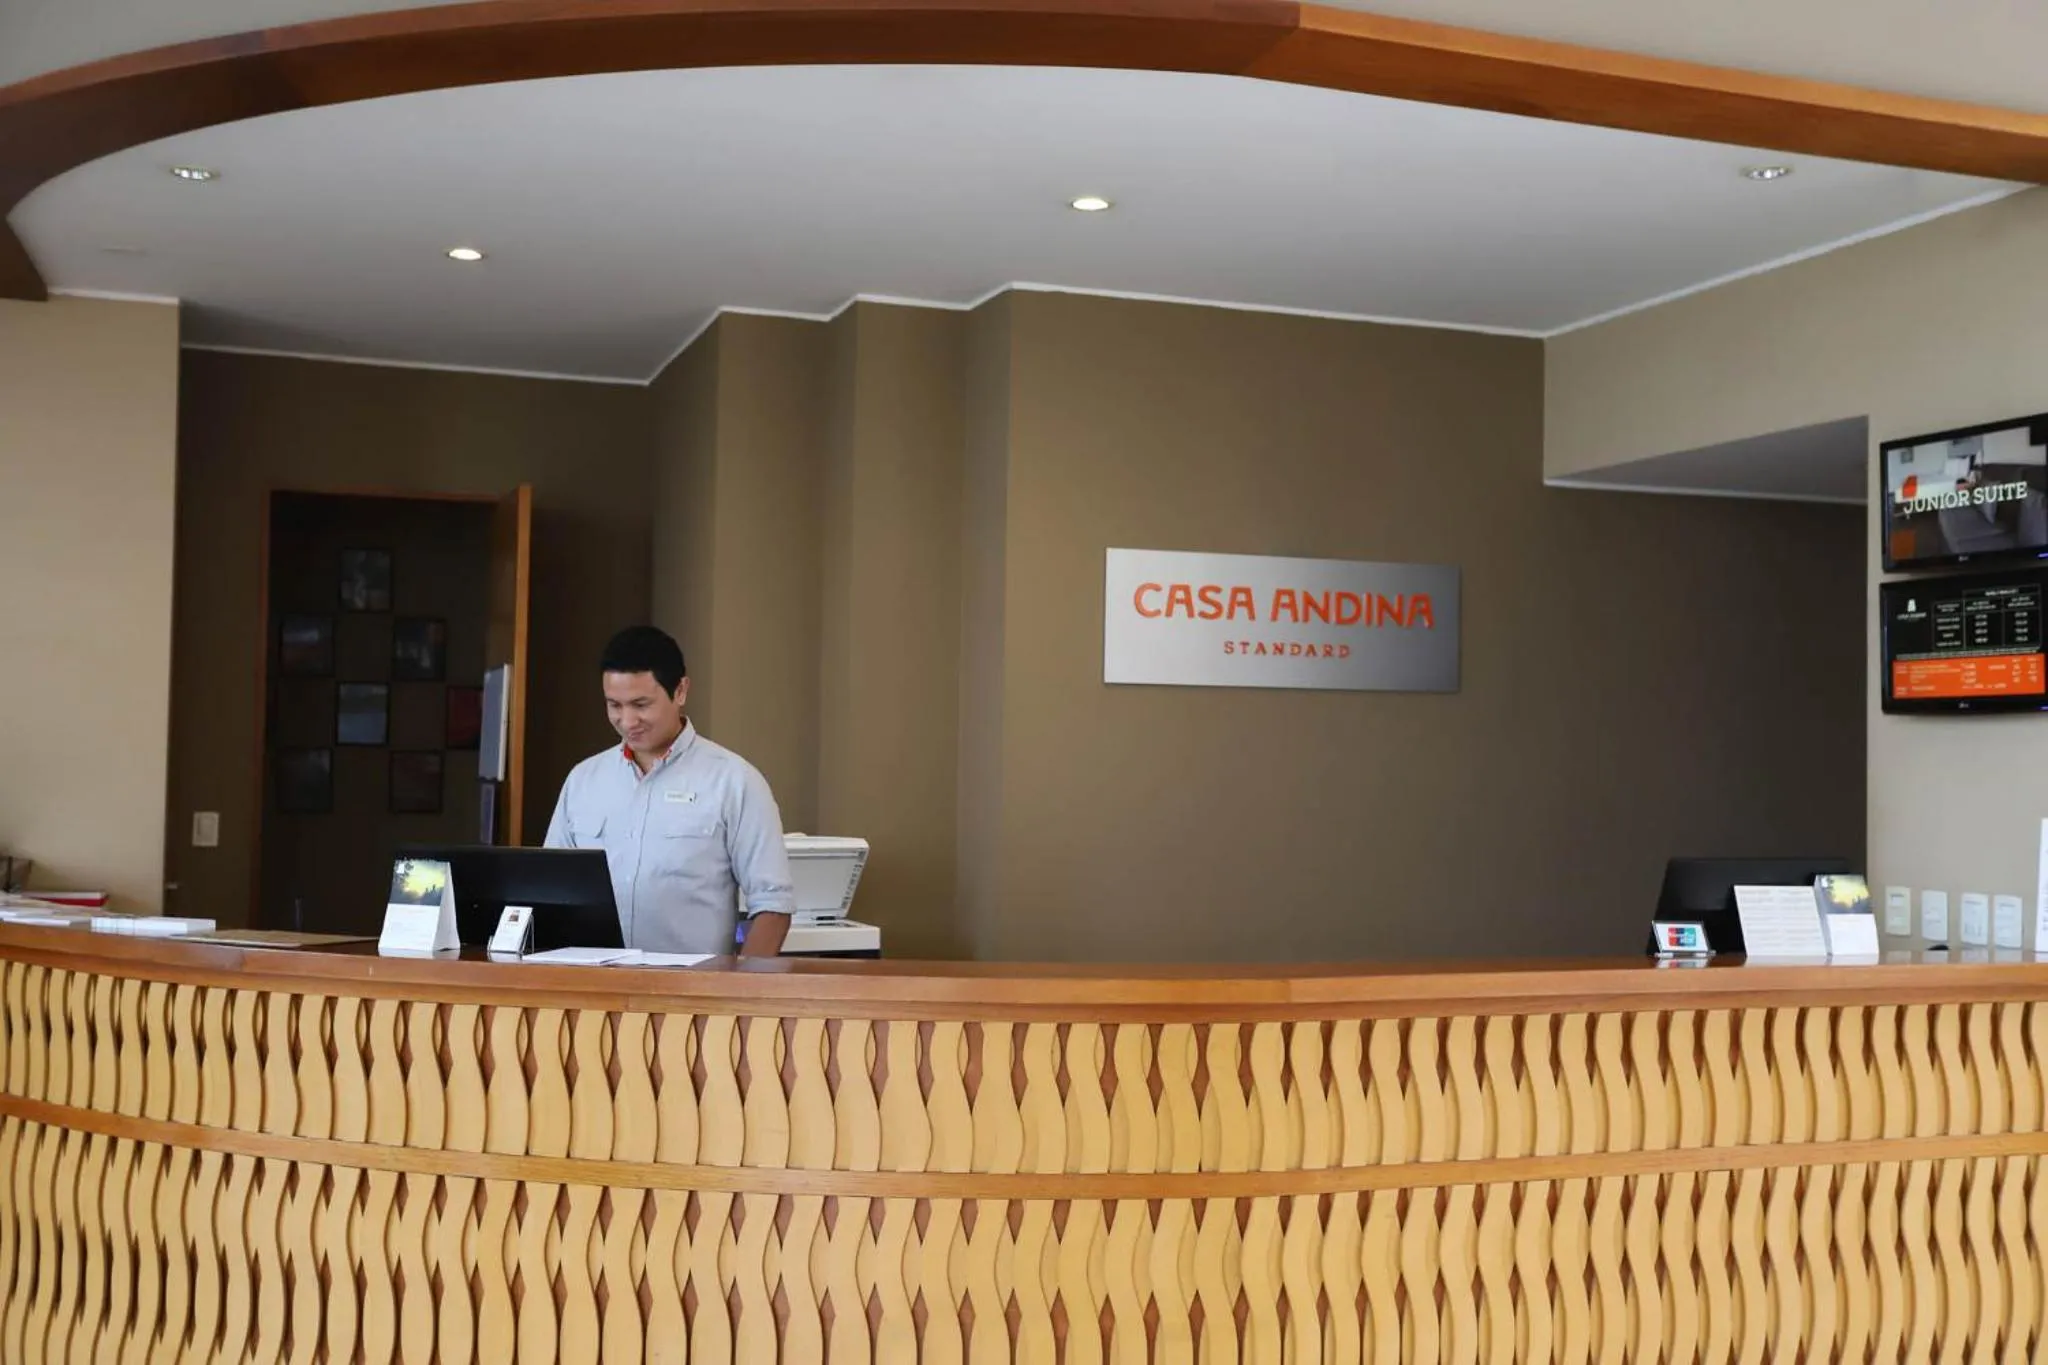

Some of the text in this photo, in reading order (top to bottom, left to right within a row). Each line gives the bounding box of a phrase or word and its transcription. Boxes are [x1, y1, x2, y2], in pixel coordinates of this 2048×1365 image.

[1903, 481, 2028, 514] JUNIOR SUITE
[1133, 582, 1435, 629] CASA ANDINA
[1223, 641, 1352, 658] STANDARD
